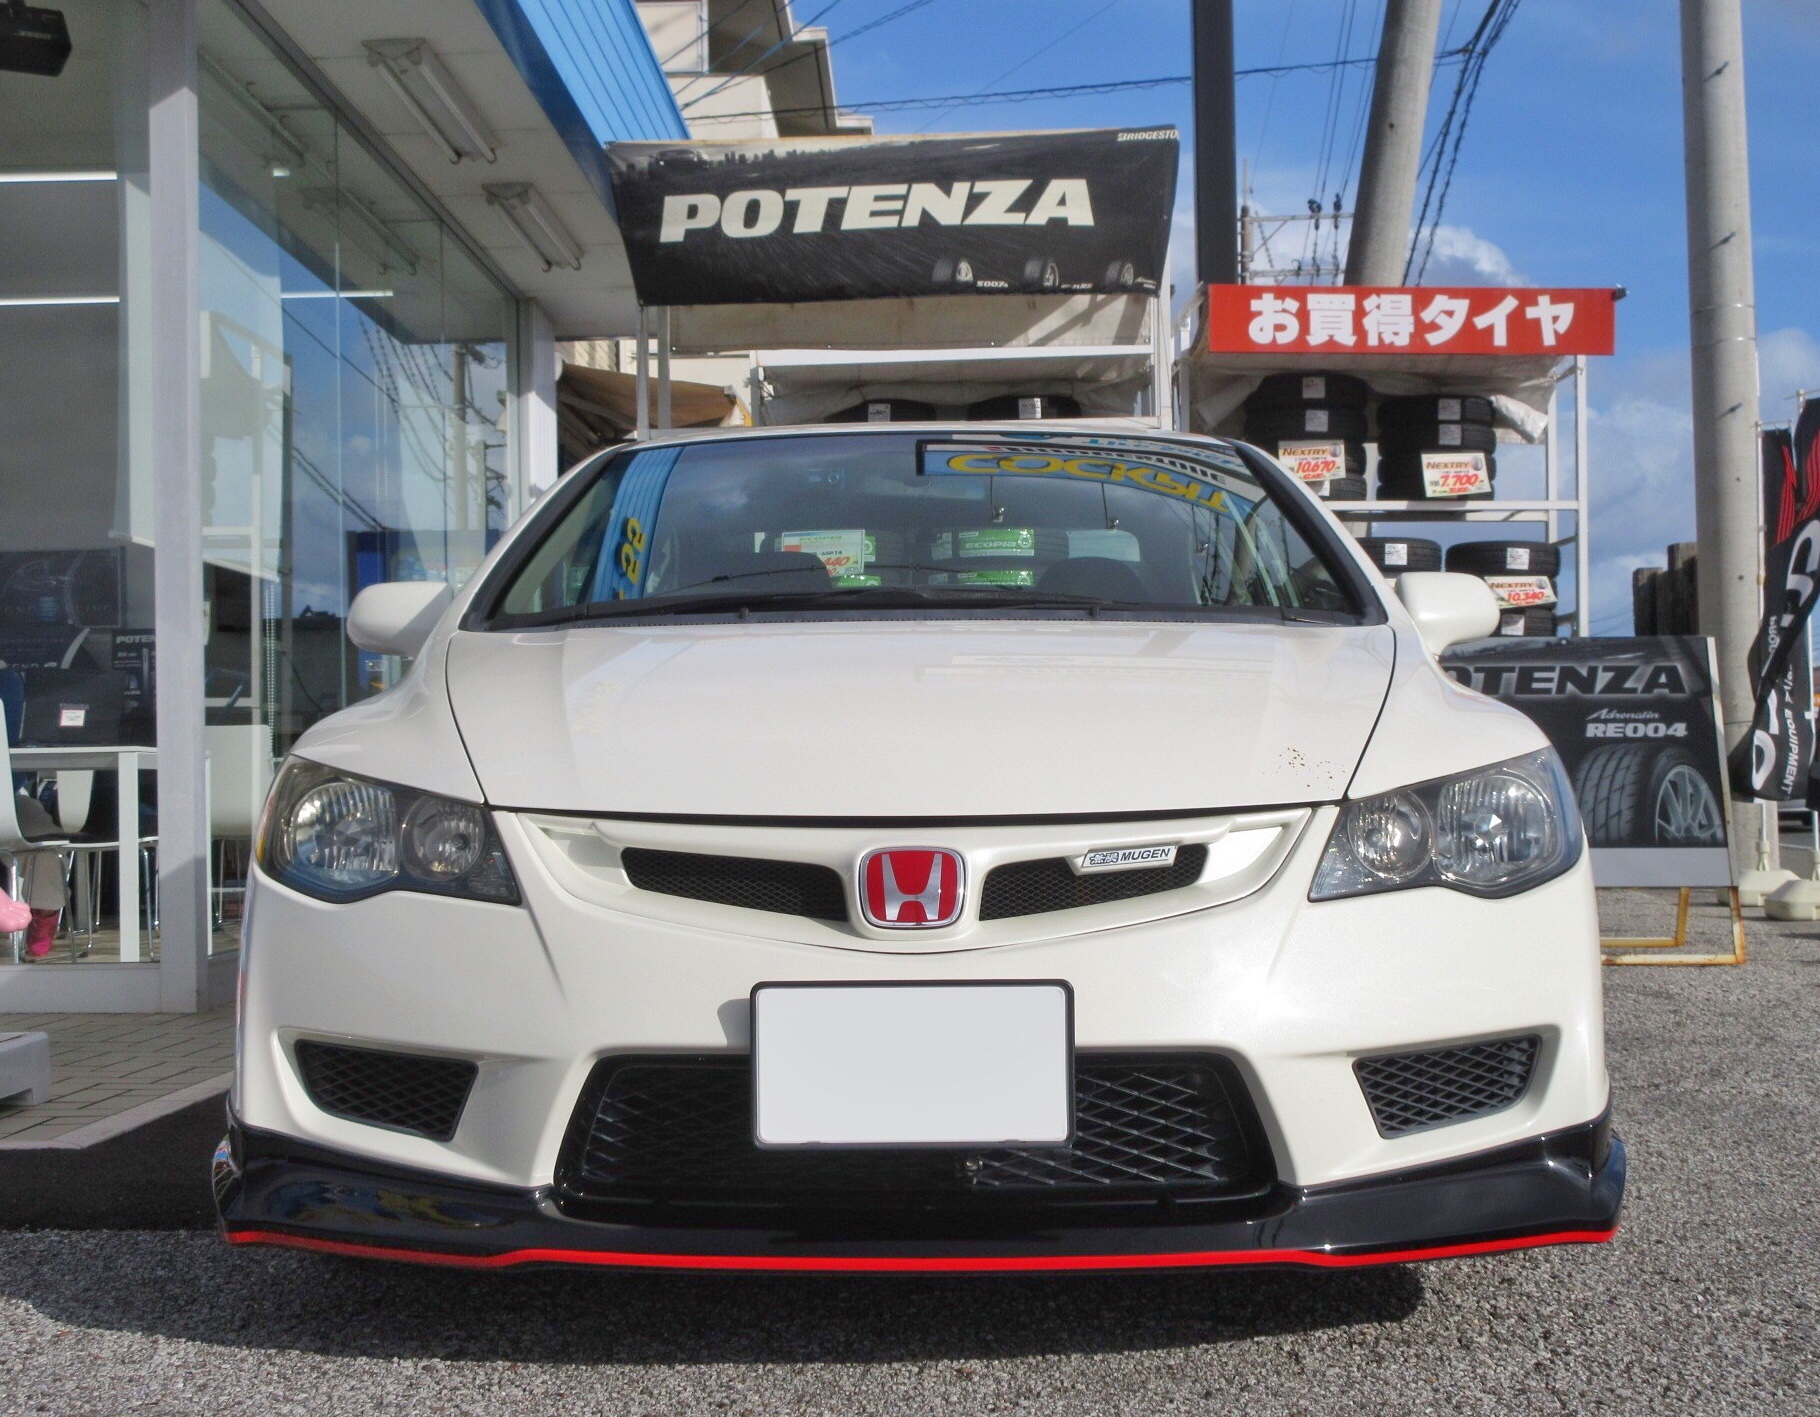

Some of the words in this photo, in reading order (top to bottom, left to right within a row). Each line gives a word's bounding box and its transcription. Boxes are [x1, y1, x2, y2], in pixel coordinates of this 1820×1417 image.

[659, 178, 1095, 243] POTENZA
[1248, 293, 1575, 347] お買得タイヤ
[1282, 447, 1329, 456] NEXTRY
[1425, 461, 1470, 470] NEXTRY
[1586, 708, 1661, 720] Adrenalin
[1585, 722, 1689, 738] RE004
[1781, 708, 1799, 795] EQUIPMENT
[1120, 848, 1171, 862] MUGEN
